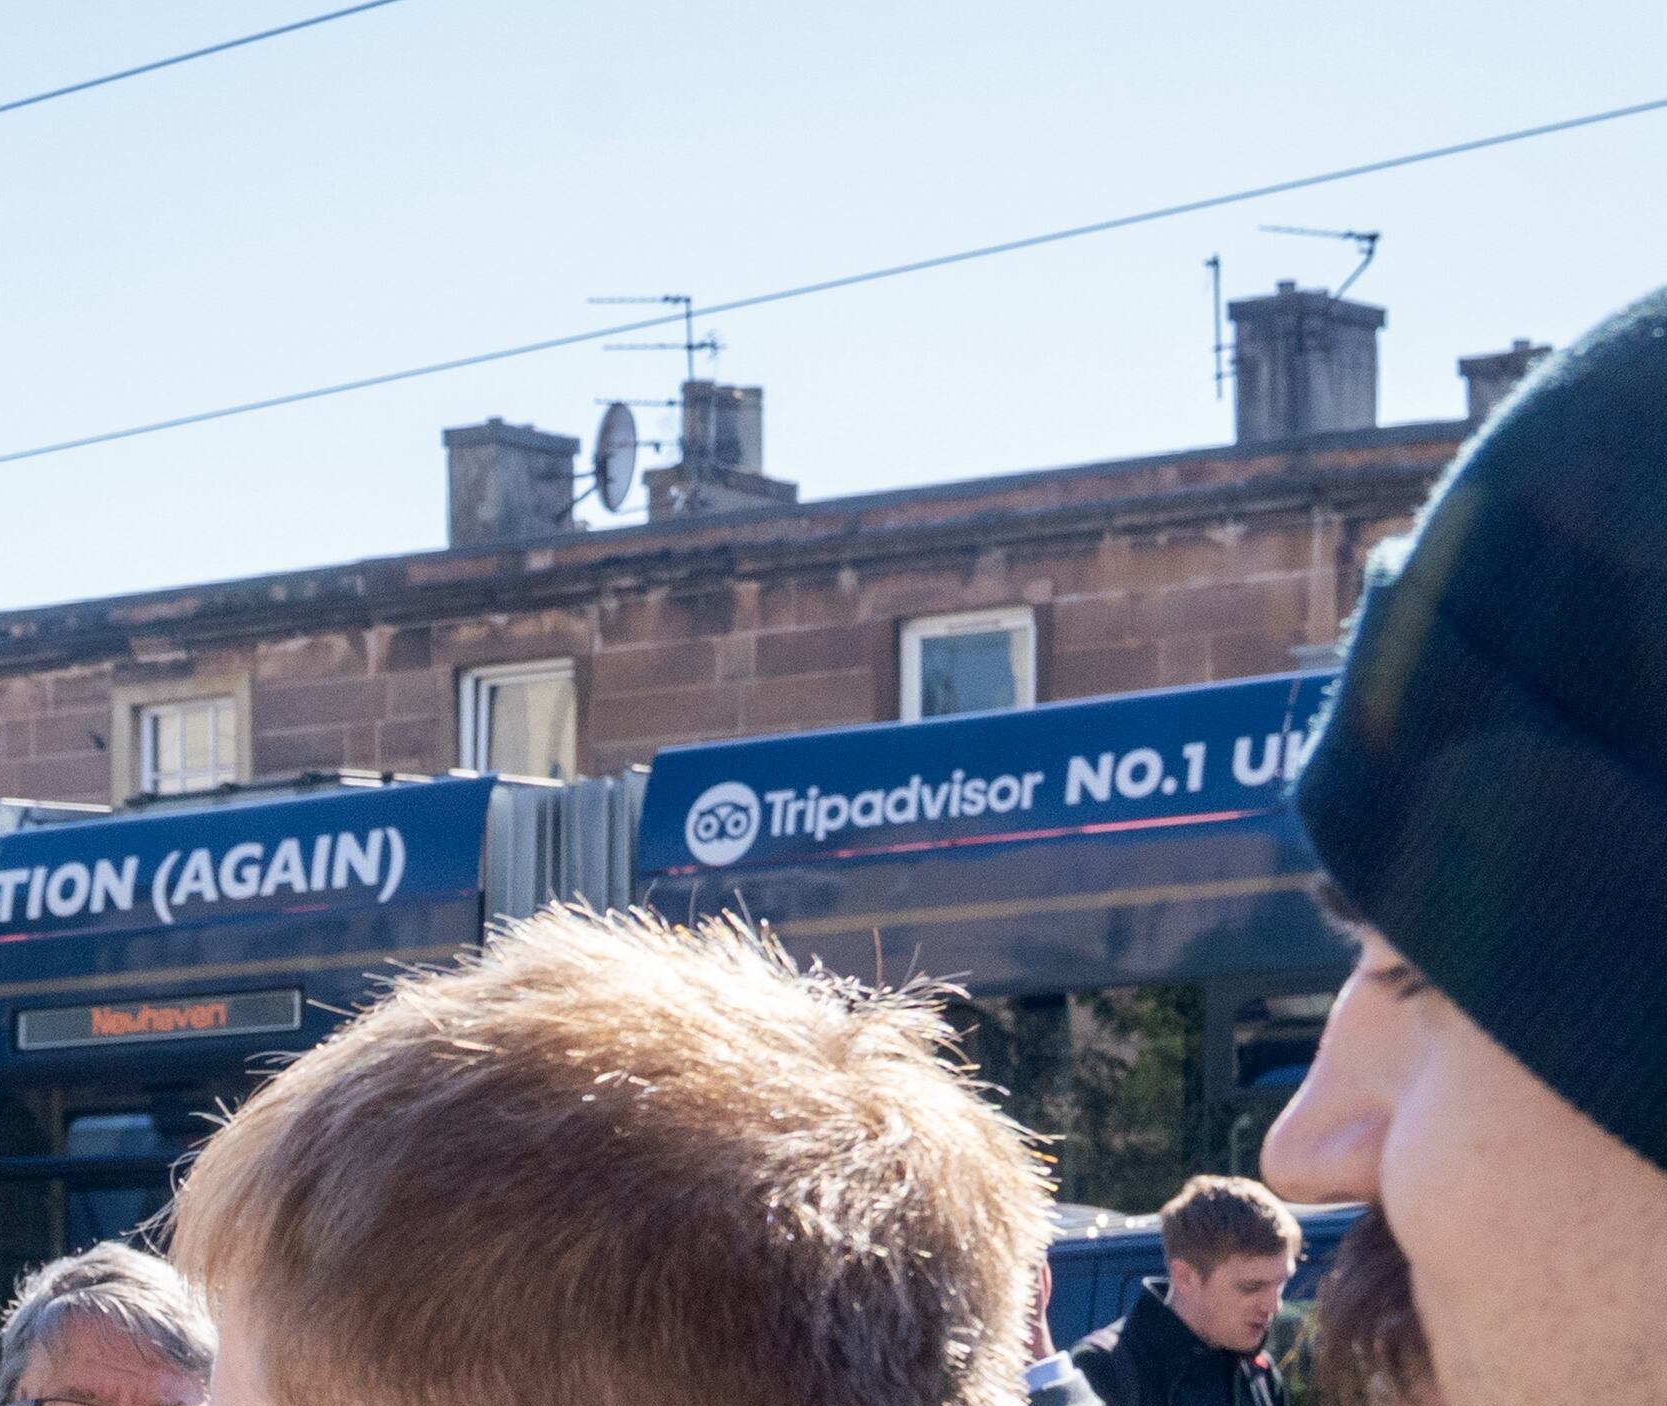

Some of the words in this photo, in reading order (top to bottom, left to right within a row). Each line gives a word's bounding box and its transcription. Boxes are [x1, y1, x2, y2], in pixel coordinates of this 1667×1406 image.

[765, 769, 1045, 841] Tripadvisor
[1066, 742, 1207, 805] NO.1
[151, 826, 407, 925] (AGAIN)
[91, 1002, 228, 1037] Newhaven
